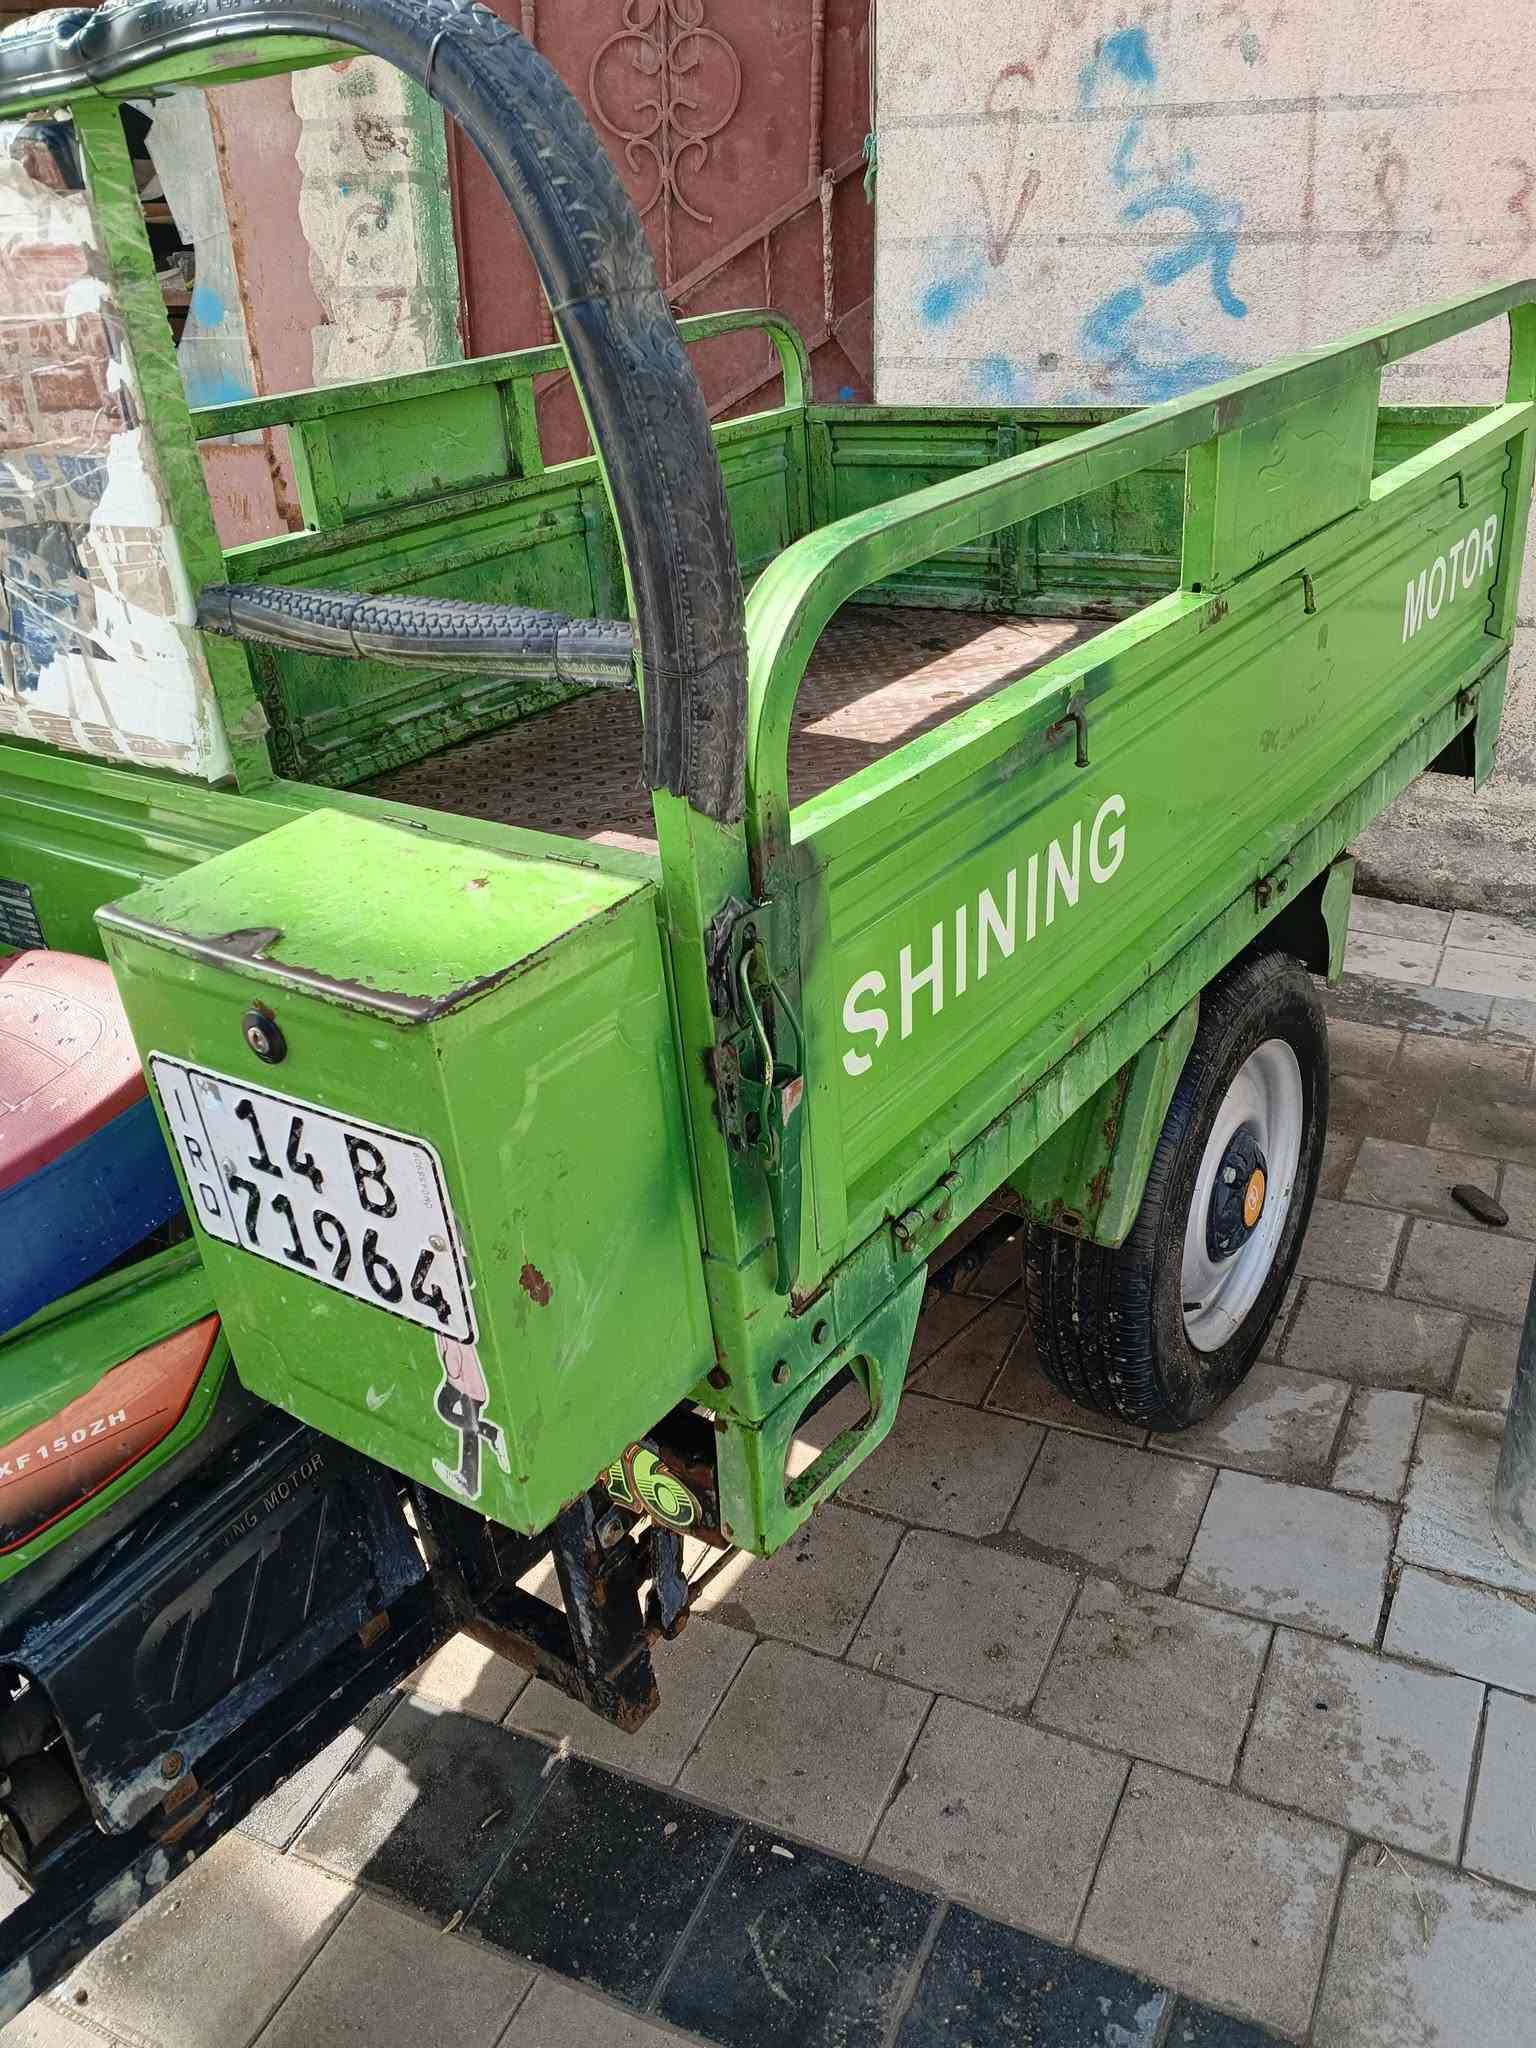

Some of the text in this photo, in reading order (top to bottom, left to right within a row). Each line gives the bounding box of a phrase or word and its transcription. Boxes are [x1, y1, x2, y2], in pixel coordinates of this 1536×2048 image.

[842, 514, 1498, 1076] SHINING MOTOR
[234, 1098, 323, 1194] 14
[343, 1133, 398, 1219] B
[229, 1175, 452, 1325] 71964
[0, 1408, 127, 1479] XF150ZH
[262, 1453, 325, 1513] MOTOR
